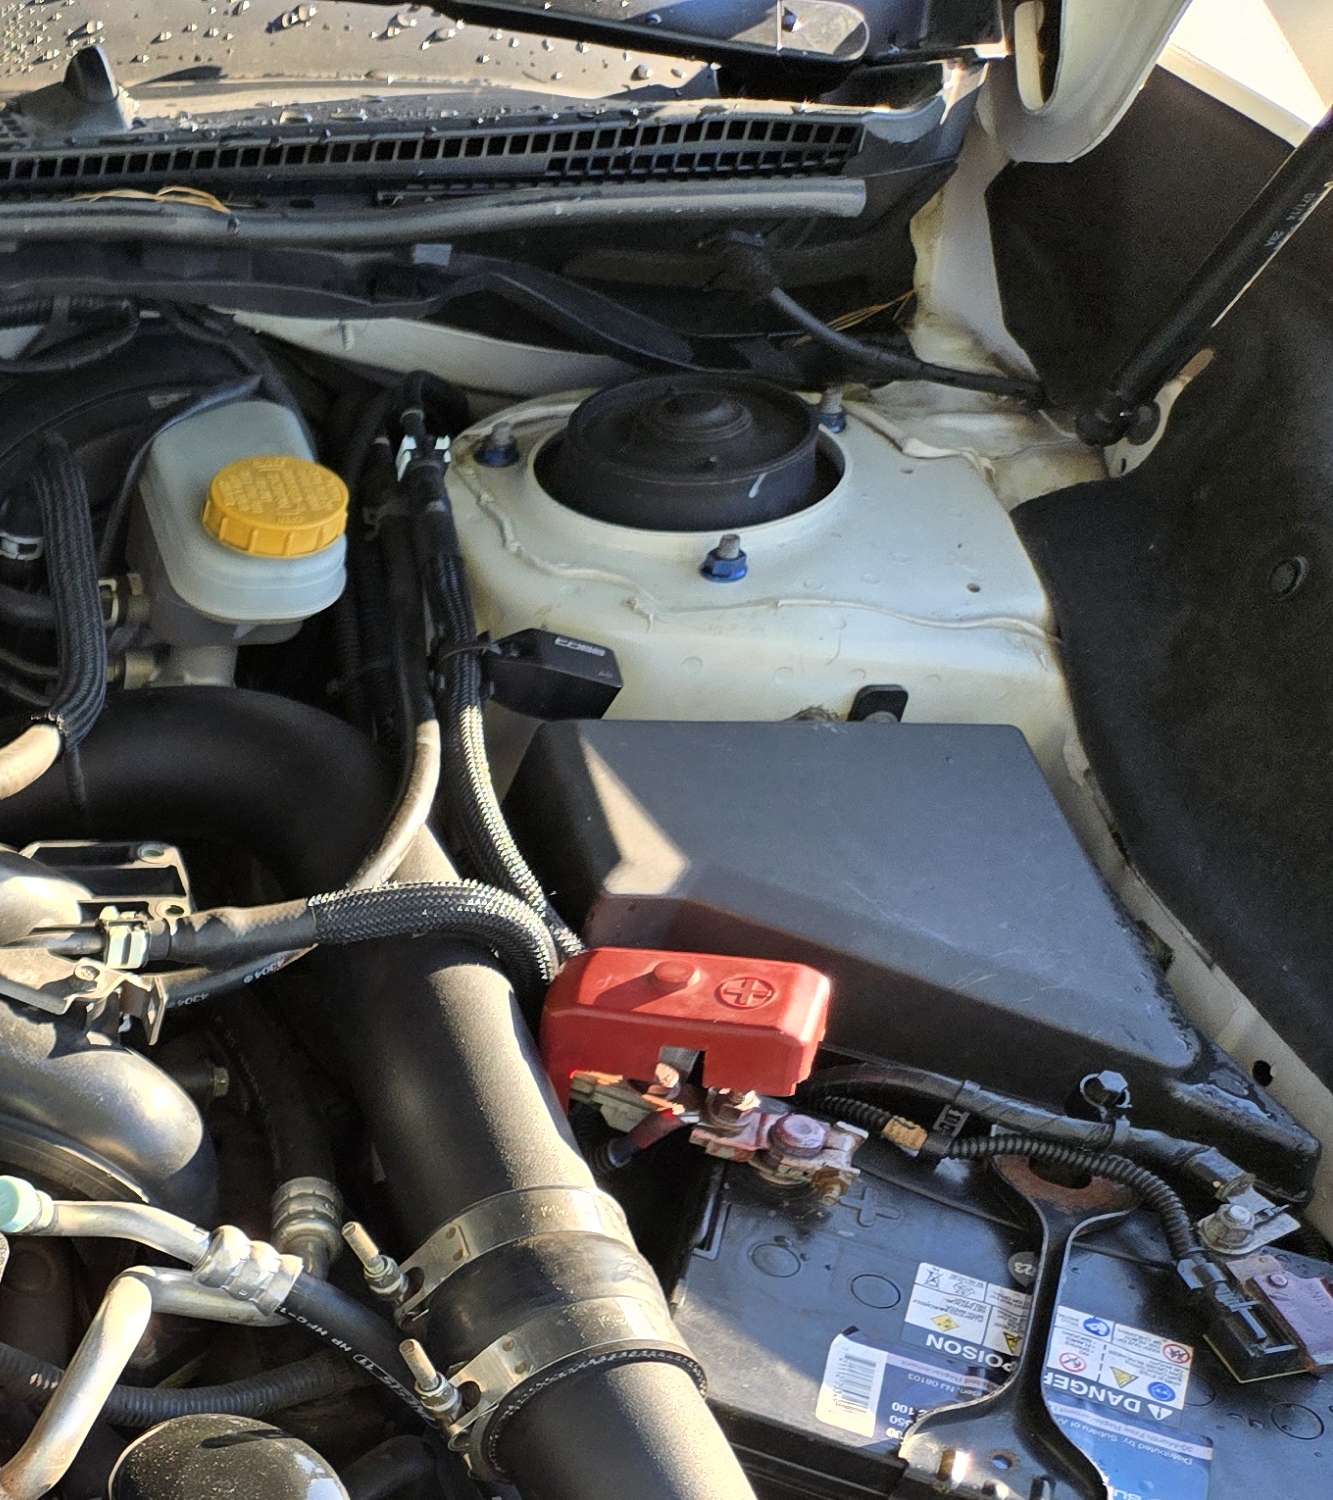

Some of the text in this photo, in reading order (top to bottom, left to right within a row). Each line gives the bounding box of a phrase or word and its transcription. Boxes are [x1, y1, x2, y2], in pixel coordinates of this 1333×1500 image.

[330, 1332, 352, 1353] HP
[925, 1333, 1018, 1373] POISON
[907, 1373, 939, 1389] 08103
[940, 1382, 955, 1393] NJ
[1083, 1425, 1118, 1442] Subaru
[1139, 1442, 1193, 1466] Distributed
